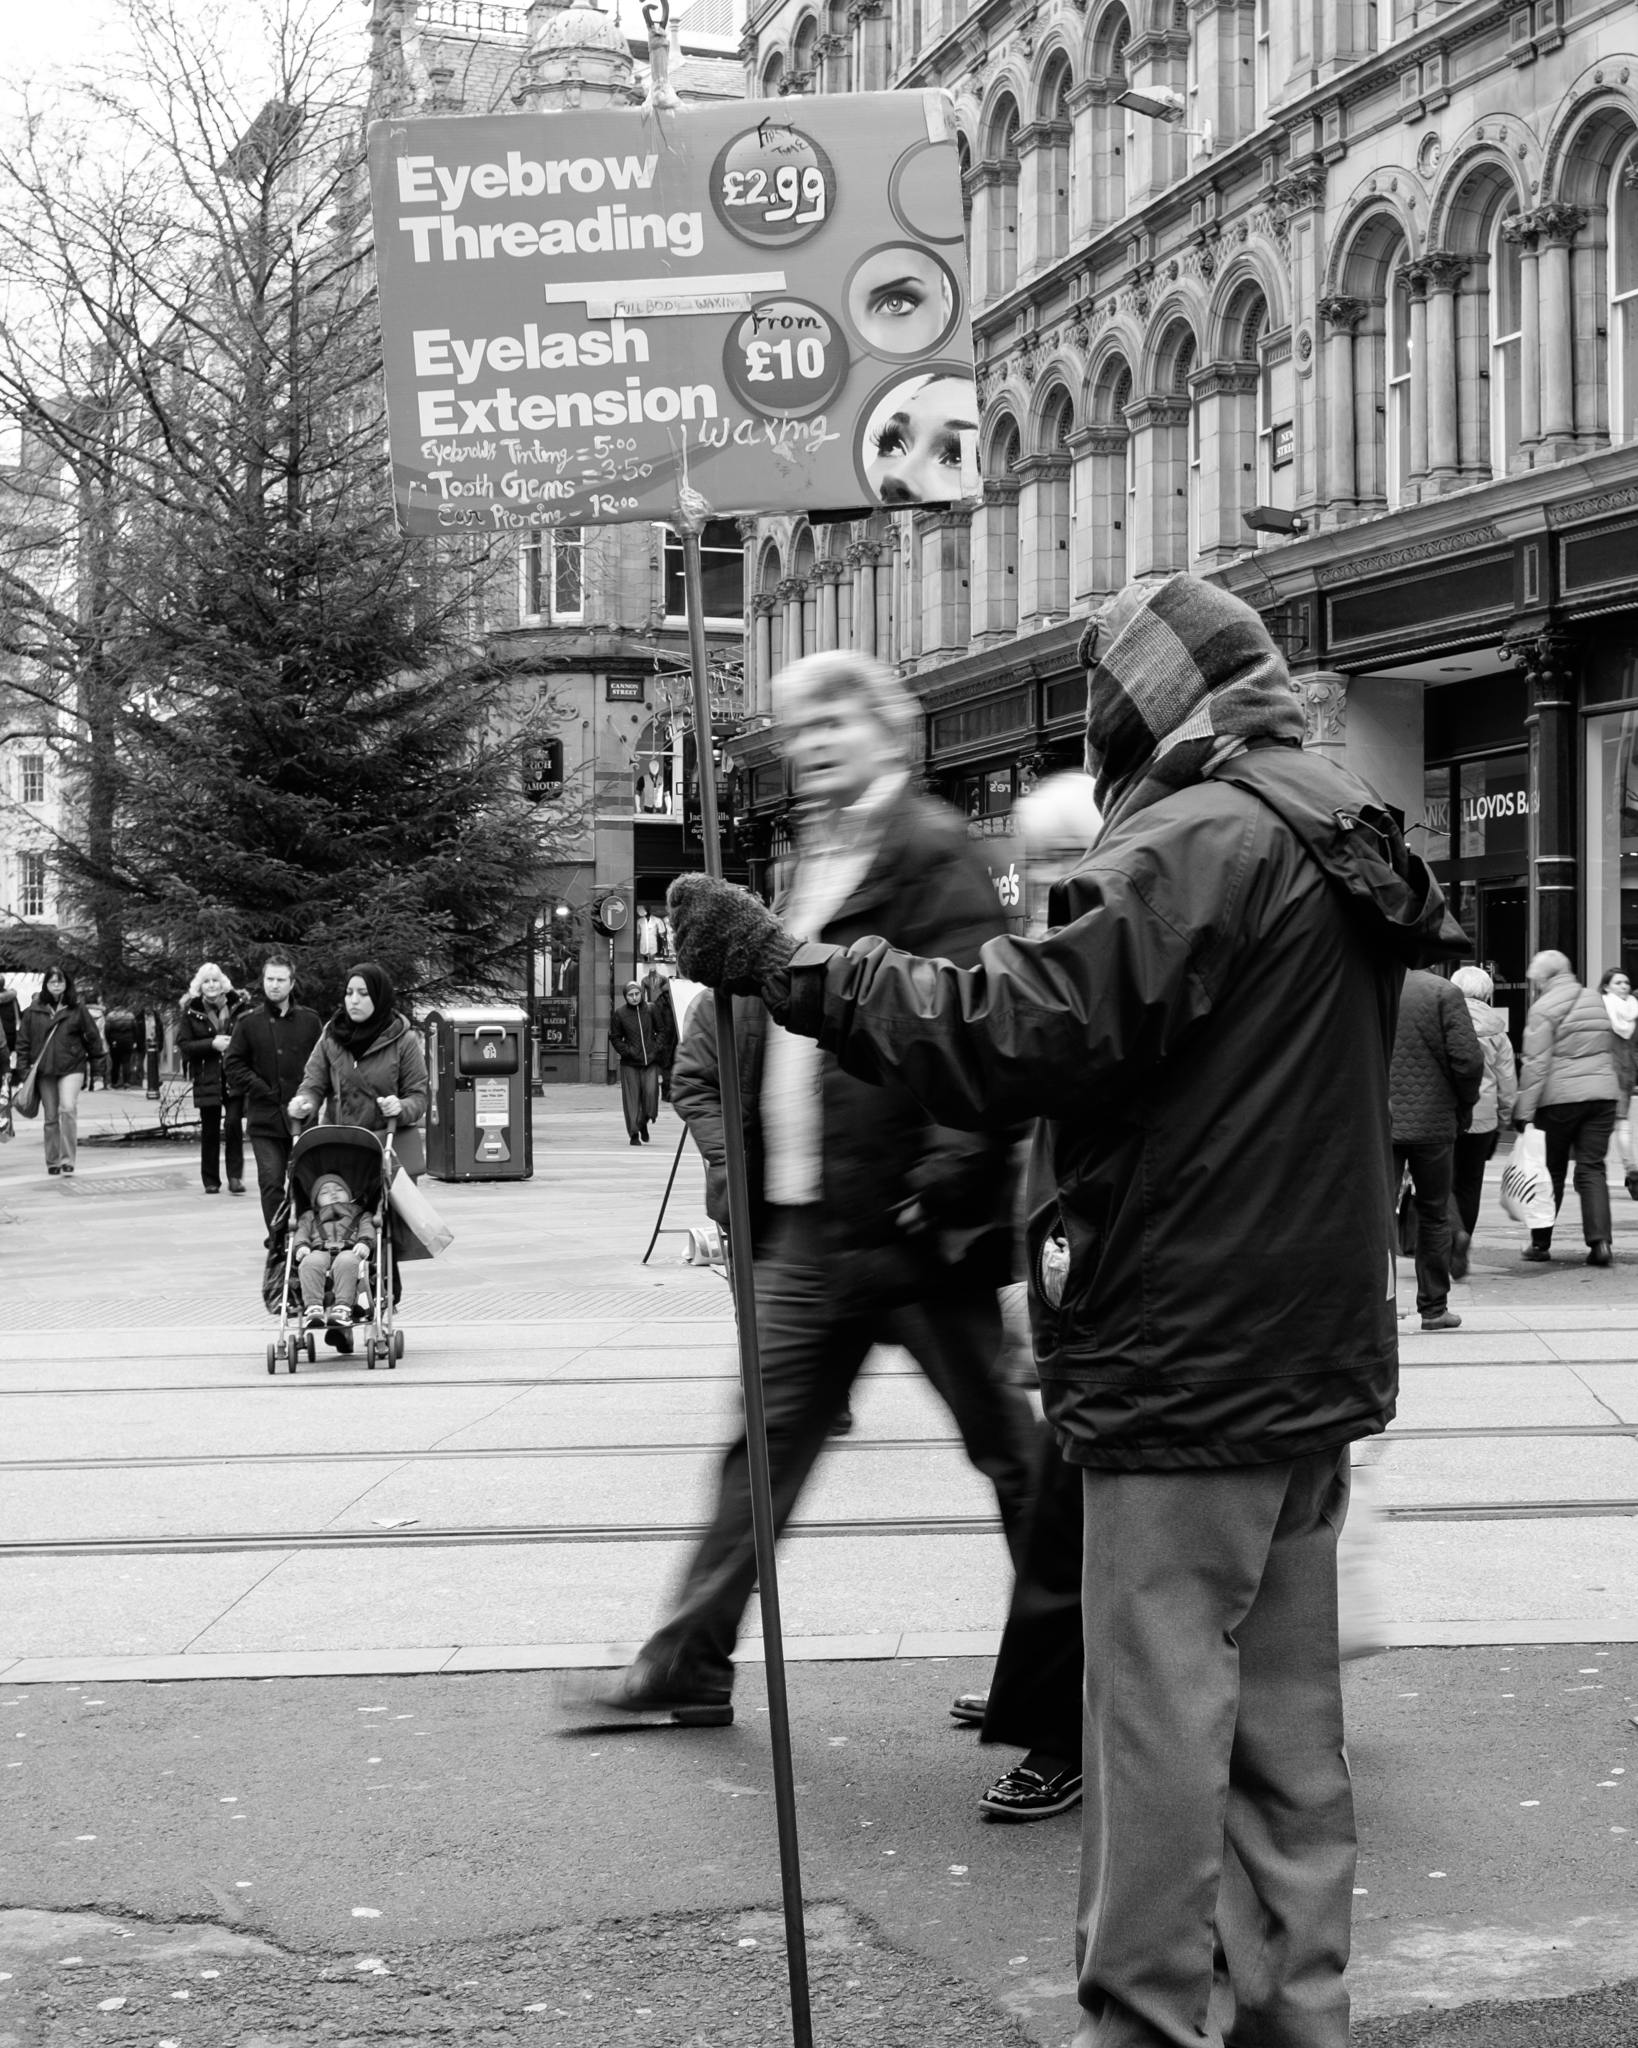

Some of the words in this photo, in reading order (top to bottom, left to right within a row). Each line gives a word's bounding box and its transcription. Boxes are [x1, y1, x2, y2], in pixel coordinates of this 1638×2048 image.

[397, 151, 659, 211] Eyebrow
[722, 165, 826, 224] £2.99
[399, 203, 704, 263] Threading
[752, 308, 822, 337] From
[413, 318, 650, 385] Eyelash
[745, 337, 825, 382] £10
[418, 376, 718, 437] Extension
[427, 470, 495, 500] Tooth
[501, 469, 575, 504] Gems
[1463, 792, 1515, 822] LLOYDS
[547, 1029, 562, 1042] £69
